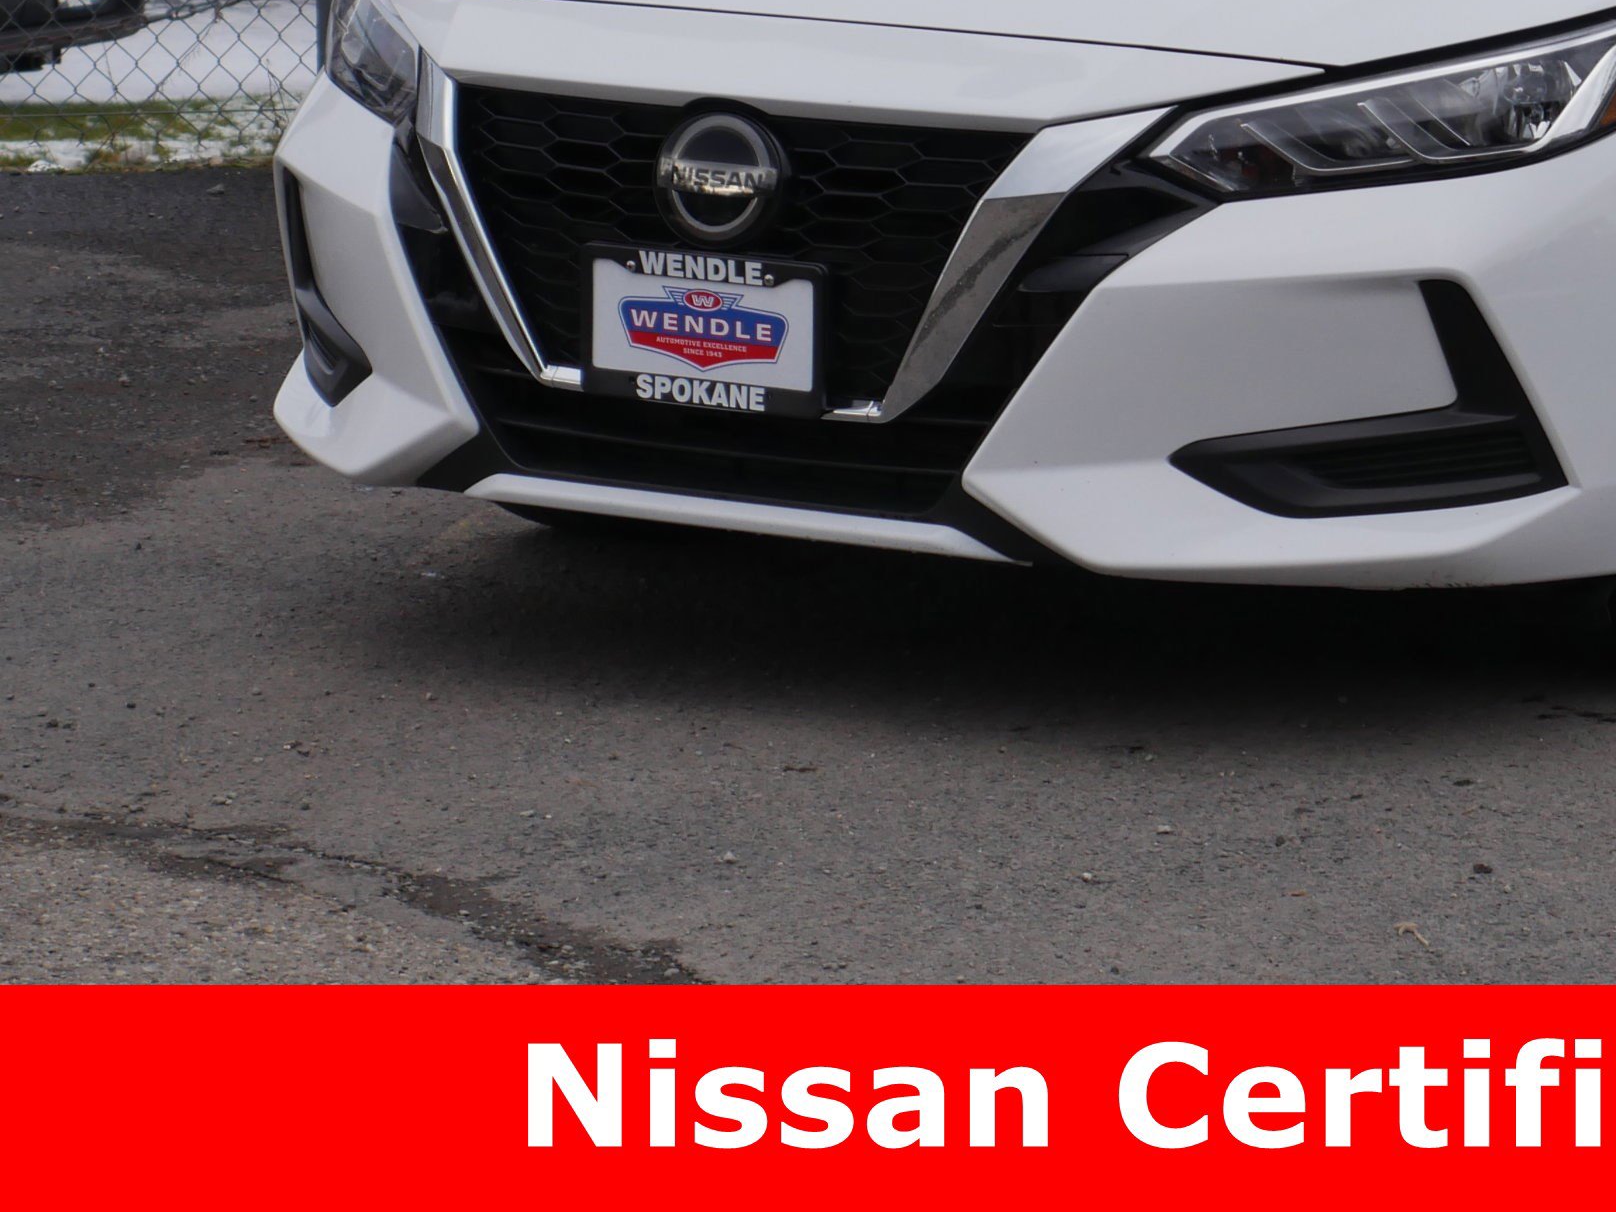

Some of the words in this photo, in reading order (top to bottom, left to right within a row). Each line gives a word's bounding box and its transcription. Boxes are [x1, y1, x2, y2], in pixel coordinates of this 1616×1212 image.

[672, 164, 764, 189] NISSAN
[639, 250, 764, 286] WENDLE
[630, 308, 772, 342] WENDLE
[656, 336, 701, 347] AUTOMOTIVE
[703, 341, 747, 353] EXCELLENCE
[683, 347, 704, 356] SINCE
[706, 350, 722, 358] 1943
[636, 373, 765, 411] SPOKANE
